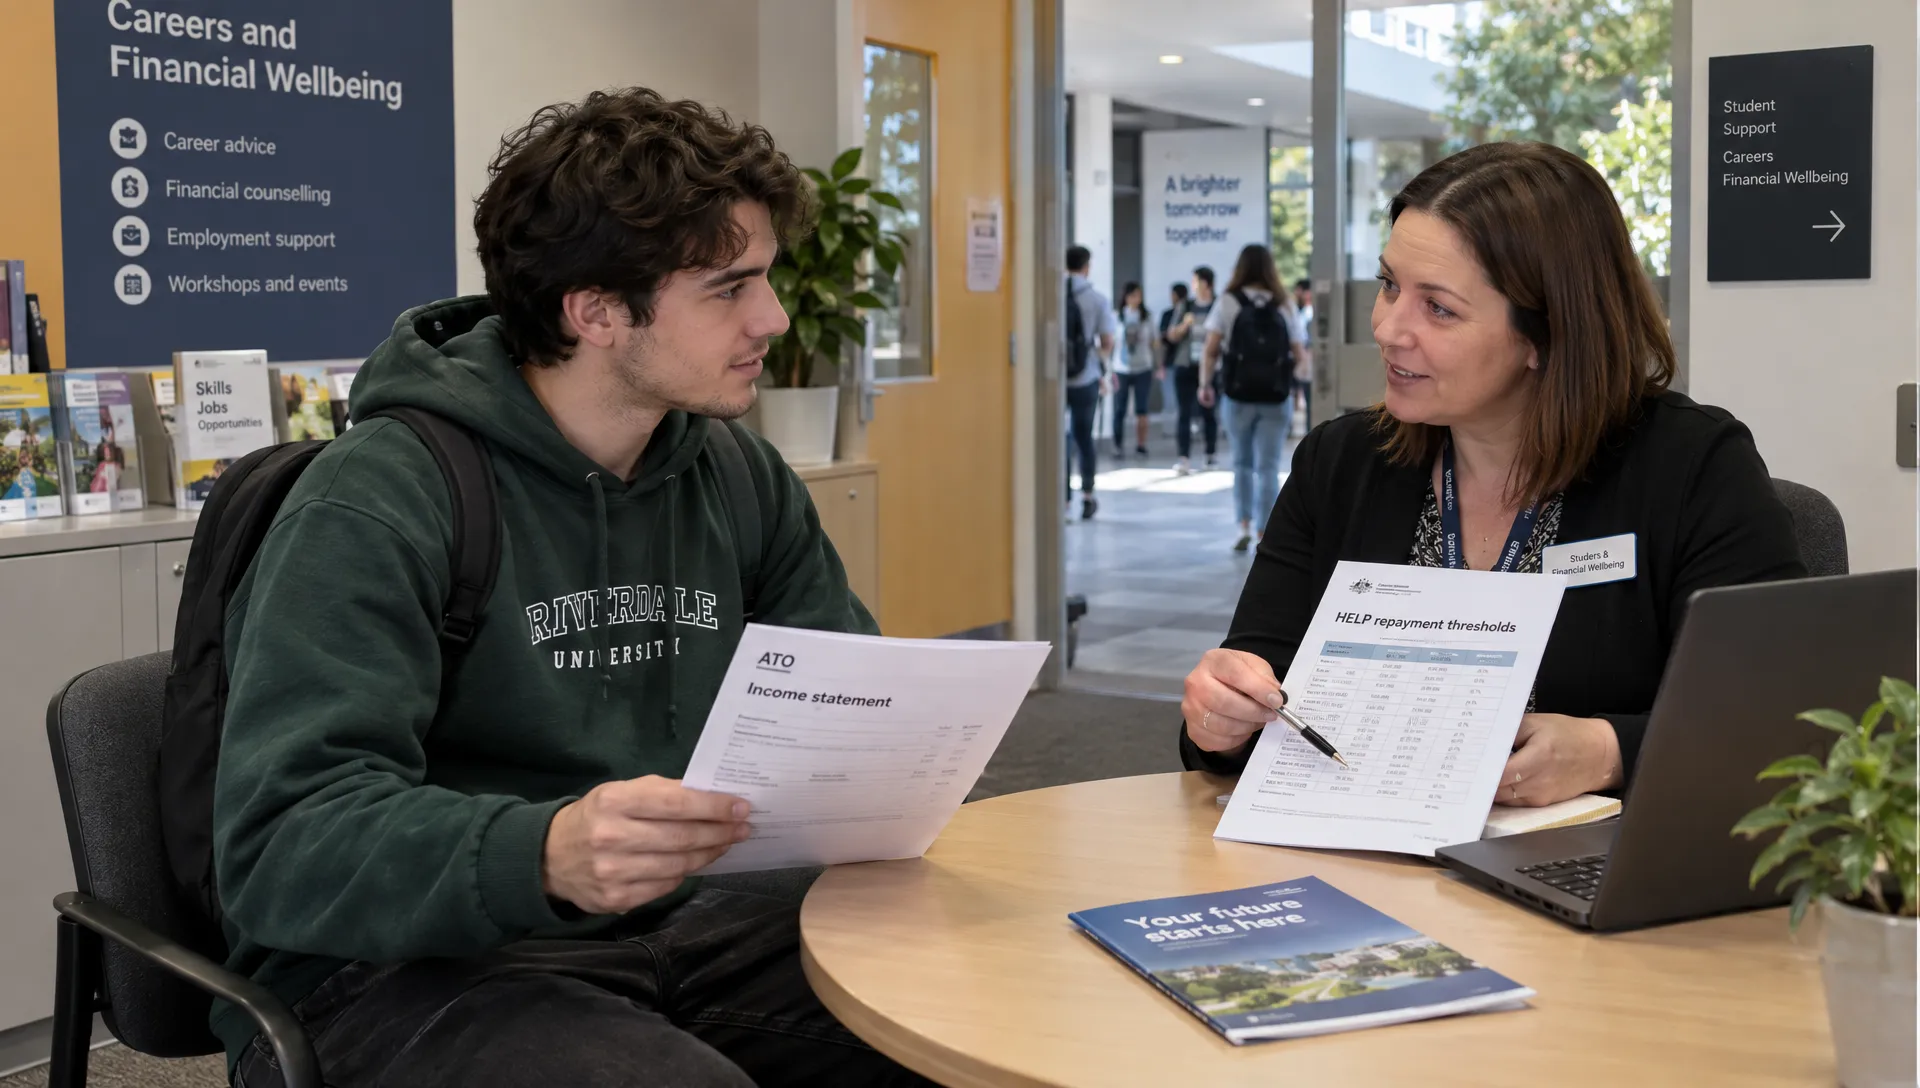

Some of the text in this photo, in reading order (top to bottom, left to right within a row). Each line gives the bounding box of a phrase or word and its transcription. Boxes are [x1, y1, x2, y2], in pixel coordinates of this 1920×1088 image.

[107, 0, 297, 50] Careers and
[110, 44, 402, 110] Financial Wellbeing
[1723, 99, 1776, 113] Student
[1723, 121, 1777, 138] Support
[163, 131, 277, 156] Career advice
[1723, 150, 1774, 164] Careers
[1165, 174, 1241, 197] A brighter
[1723, 169, 1849, 186] Financial Wellbeing
[166, 179, 331, 206] Financial counselling
[1165, 202, 1241, 217] tomorrow
[167, 227, 336, 251] Employment support
[1165, 225, 1228, 246] together
[168, 274, 348, 296] Workshops and events
[195, 380, 232, 396] Skills
[197, 401, 228, 415] Jobs
[198, 418, 263, 432] Opportunities
[1587, 560, 1625, 572] Wellbeing
[1335, 611, 1517, 633] HELP repayment thresholds
[553, 637, 680, 669] UNIERSIT
[757, 651, 795, 669] ATO
[747, 682, 893, 709] Income statement
[1123, 899, 1303, 930] Your future
[1145, 922, 1236, 943] starts
[1232, 913, 1307, 931] here
